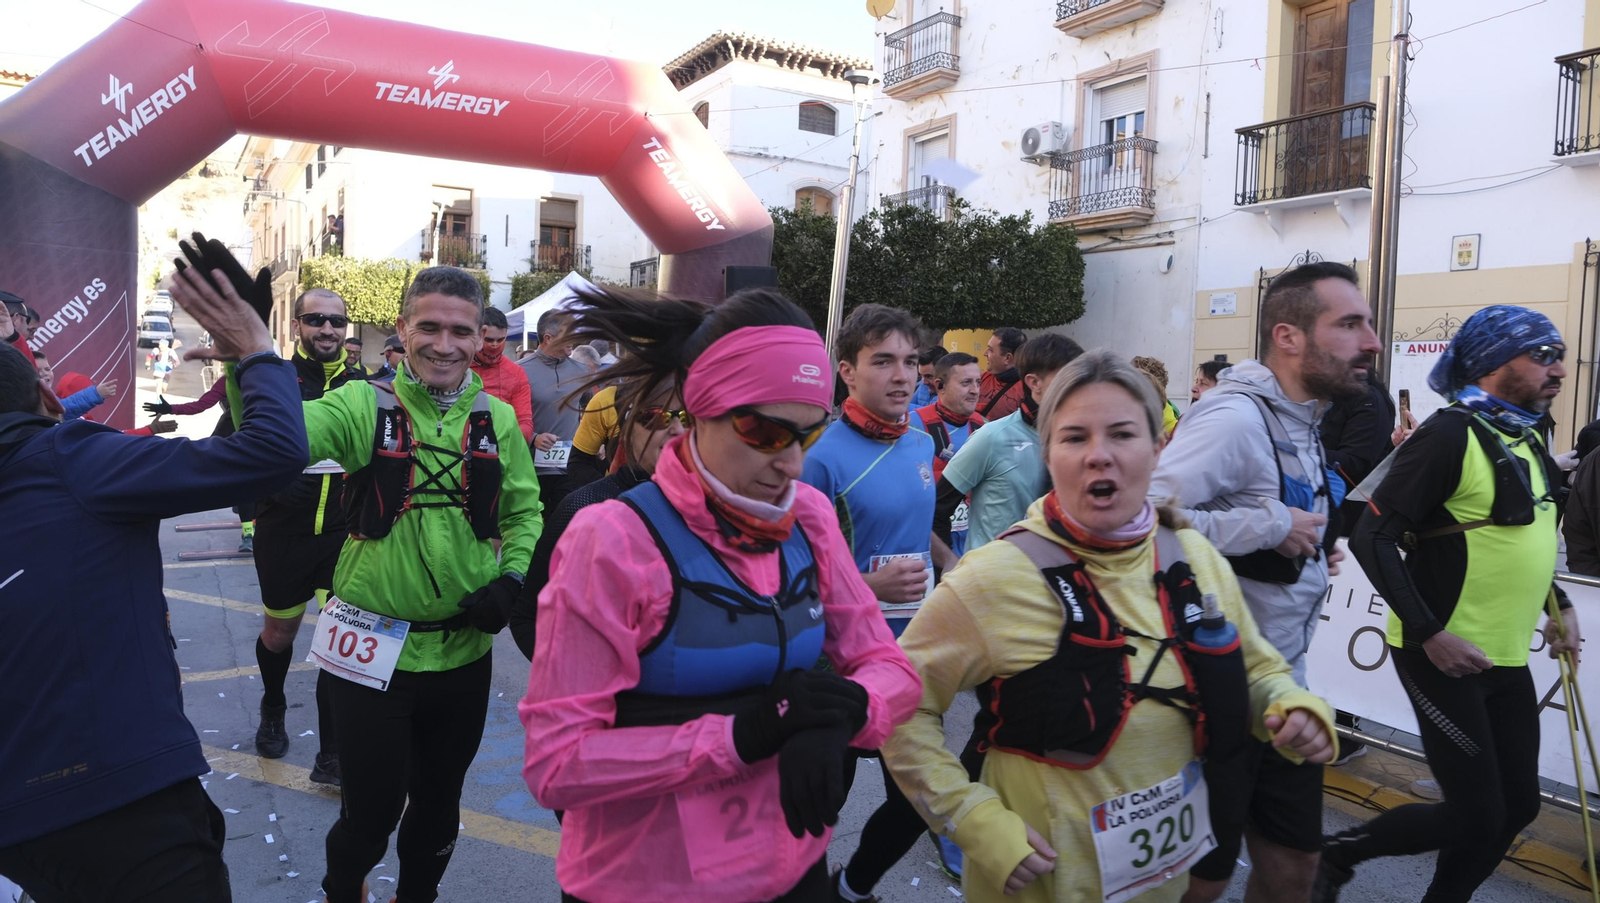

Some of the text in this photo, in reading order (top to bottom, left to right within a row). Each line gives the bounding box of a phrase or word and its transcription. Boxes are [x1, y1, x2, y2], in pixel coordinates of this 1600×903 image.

[73, 65, 197, 168] TEAMERGY
[375, 81, 511, 117] TEAMERGY
[642, 136, 726, 231] TEAMERGY
[1407, 343, 1449, 354] ANUN
[543, 449, 566, 461] 372
[328, 625, 379, 664] 103
[1110, 796, 1126, 812] IV
[1131, 785, 1163, 806] CxM
[1108, 815, 1127, 829] LA
[1129, 802, 1195, 869] 320
